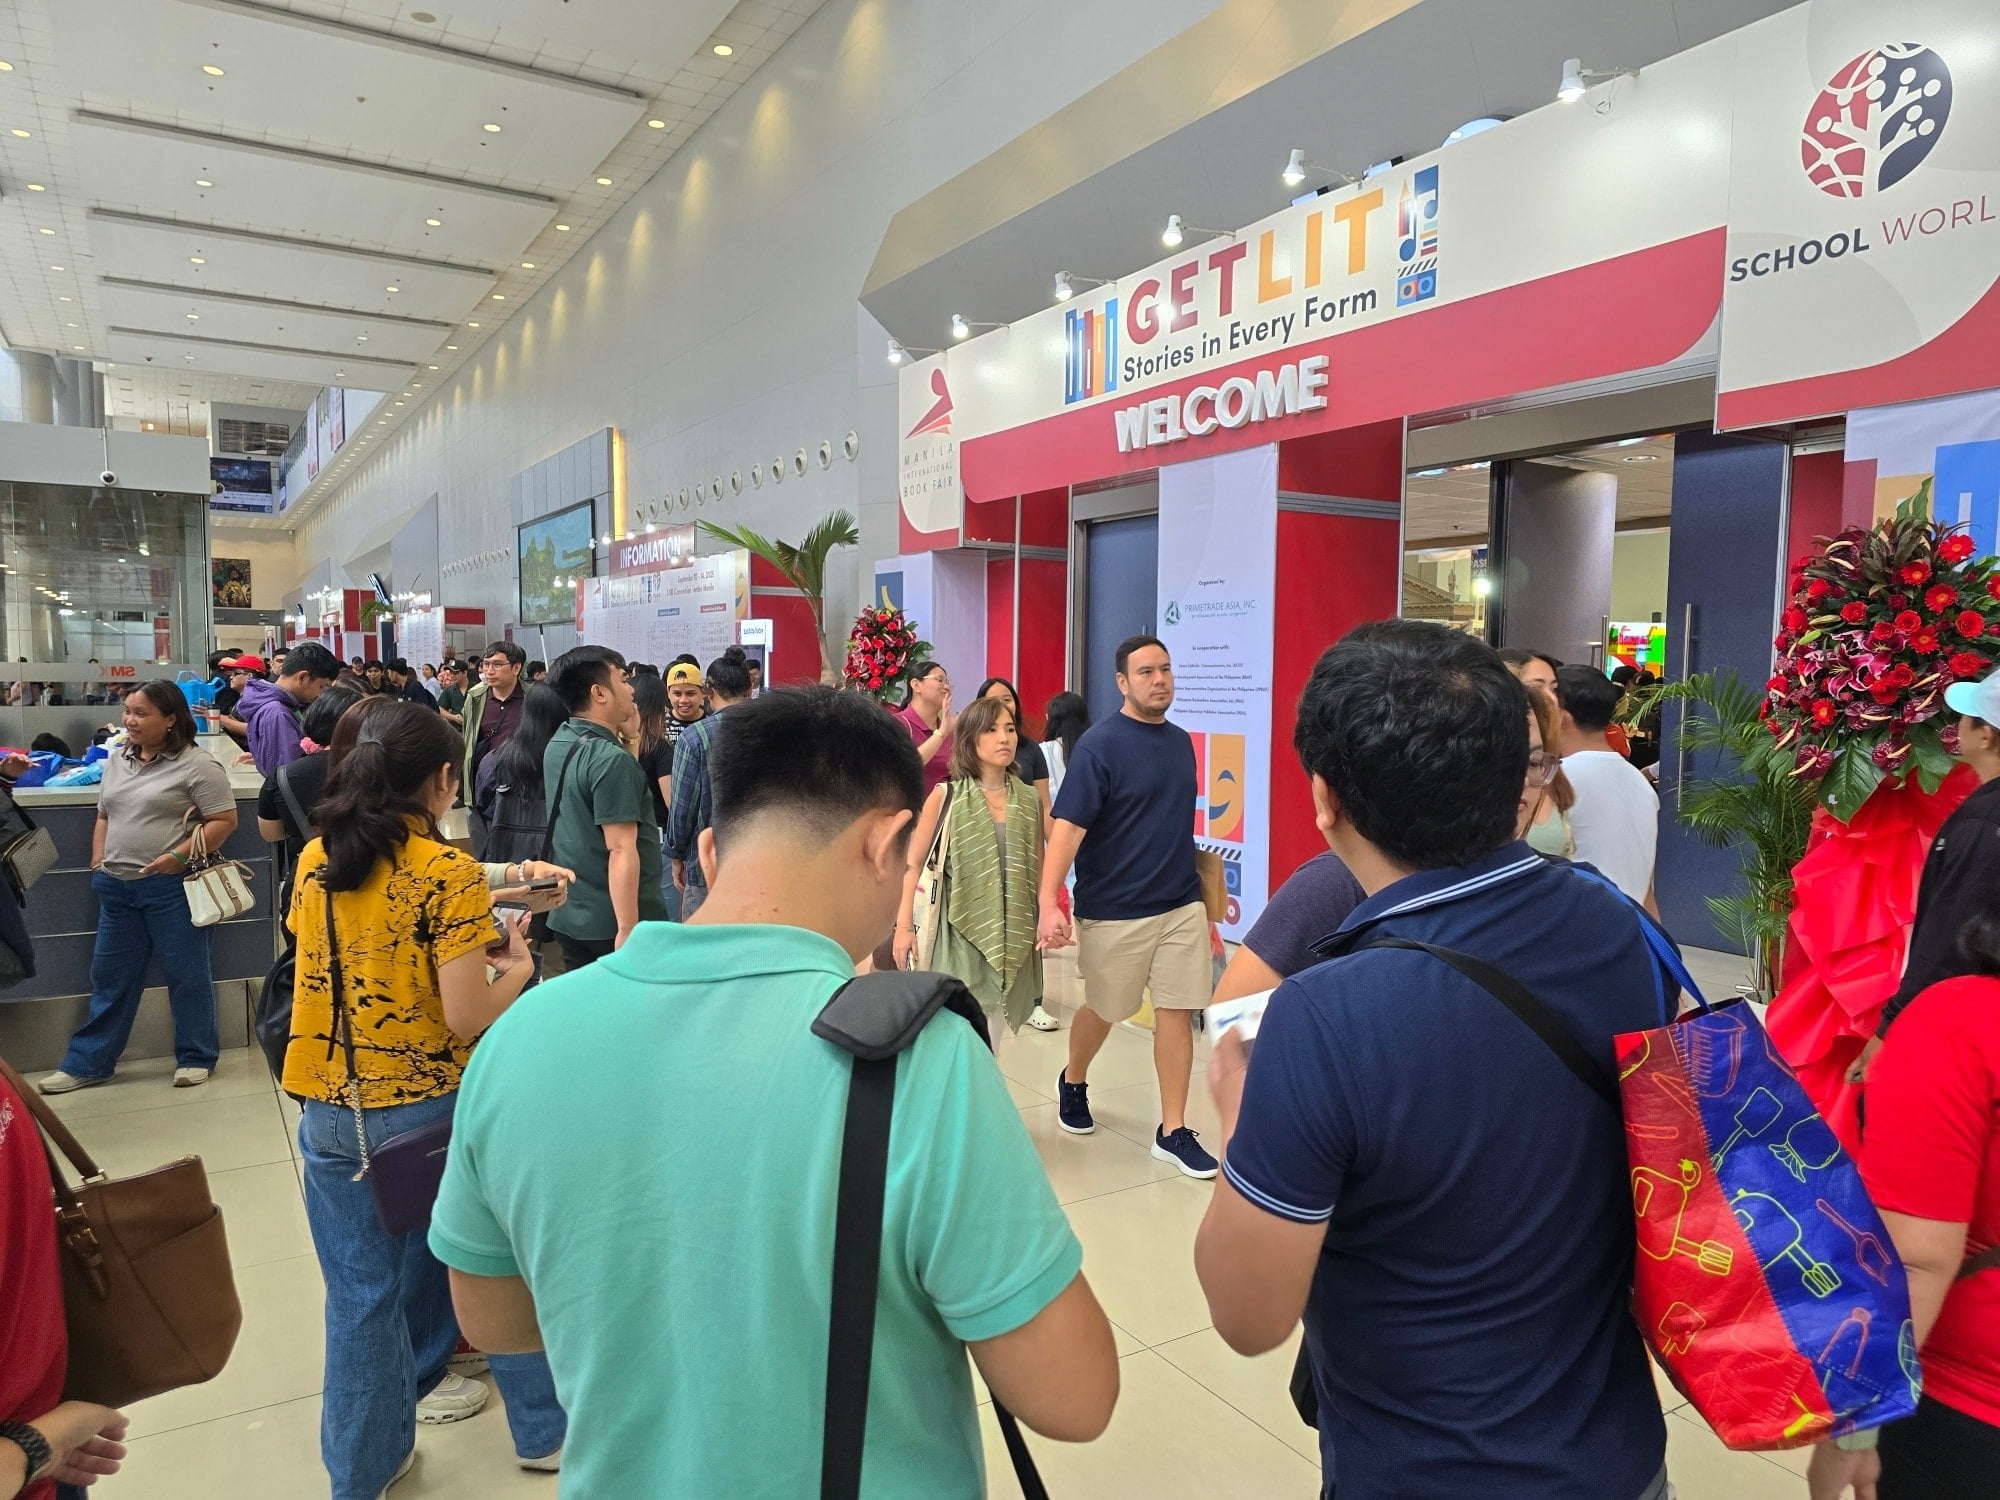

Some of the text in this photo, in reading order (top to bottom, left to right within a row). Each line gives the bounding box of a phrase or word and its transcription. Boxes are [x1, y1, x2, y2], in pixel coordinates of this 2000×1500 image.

[1729, 228, 1870, 282] SCHOOL
[1123, 288, 1378, 383] Stories in Every Form
[1114, 355, 1329, 452] WELCOME
[904, 443, 953, 466] MANILA
[904, 476, 953, 498] BOOK FAIR
[620, 535, 682, 569] INFORMATION
[1184, 601, 1224, 613] PRIMETRADE
